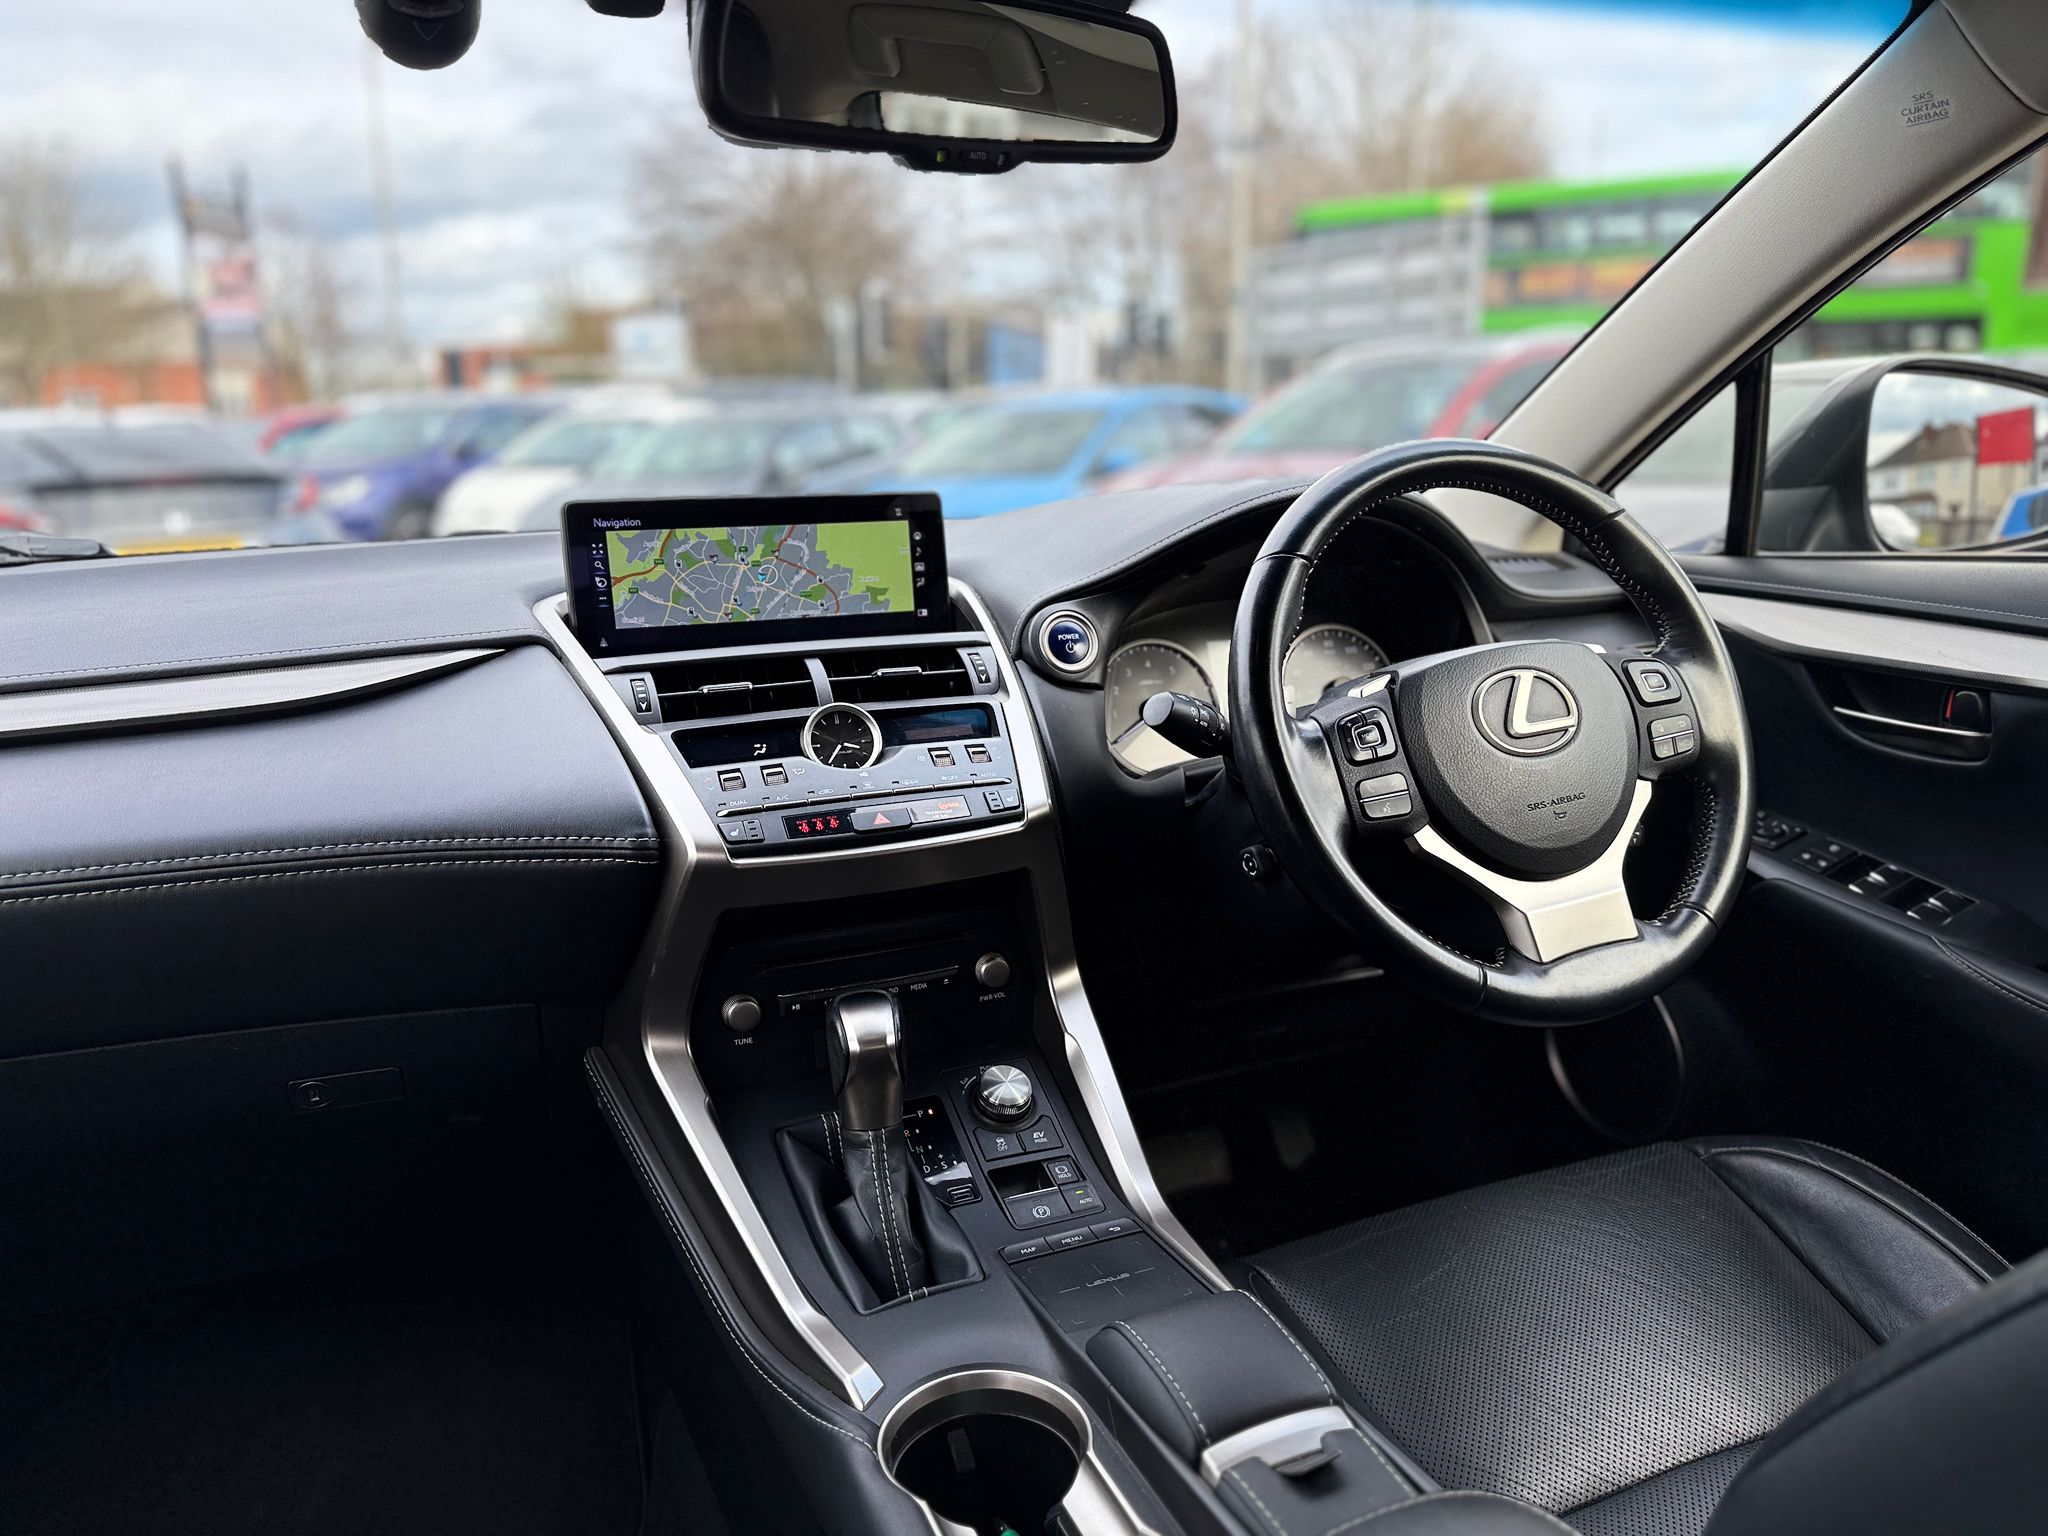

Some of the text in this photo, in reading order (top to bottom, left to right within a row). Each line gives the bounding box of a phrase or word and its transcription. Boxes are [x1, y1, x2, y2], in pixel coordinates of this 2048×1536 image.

[1912, 90, 1935, 103] SRS
[1901, 98, 1950, 116] CURTAIN
[1906, 108, 1949, 125] AIRBAG
[969, 151, 987, 160] AUTO
[593, 518, 641, 529] Navigation
[1057, 633, 1080, 641] POWER
[729, 799, 748, 807] DUAL
[1526, 792, 1586, 812] SRS-AIRBAG
[910, 983, 928, 992] MEDIA
[733, 1037, 753, 1046] TUNE
[917, 1110, 924, 1118] P
[903, 1129, 911, 1138] R
[1033, 1131, 1045, 1139] EV
[915, 1145, 924, 1154] N
[922, 1161, 948, 1174] D S
[1061, 1235, 1083, 1244] MENU
[1020, 1246, 1037, 1254] MAP
[1086, 1272, 1130, 1287] LEXUS
